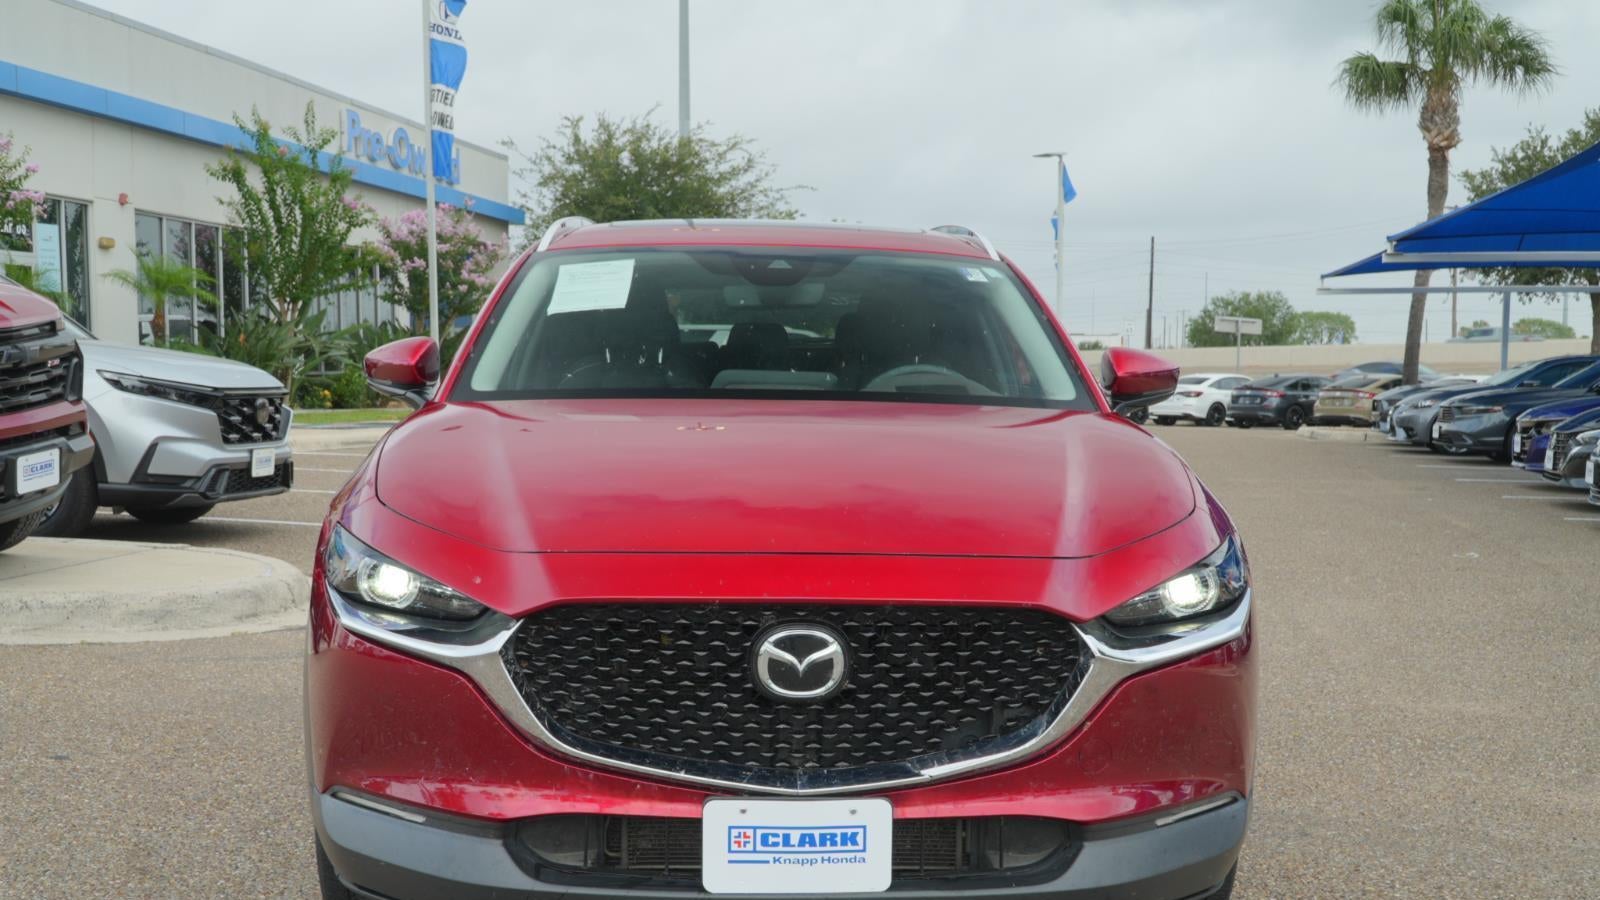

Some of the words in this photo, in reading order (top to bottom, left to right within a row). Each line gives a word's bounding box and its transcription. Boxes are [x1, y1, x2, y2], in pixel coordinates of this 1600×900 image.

[429, 22, 463, 41] HON
[345, 108, 460, 185] Pre-Owd
[30, 462, 53, 472] CLARK
[760, 831, 860, 848] CLARK
[772, 856, 818, 866] Knapp
[821, 855, 866, 864] Honda
